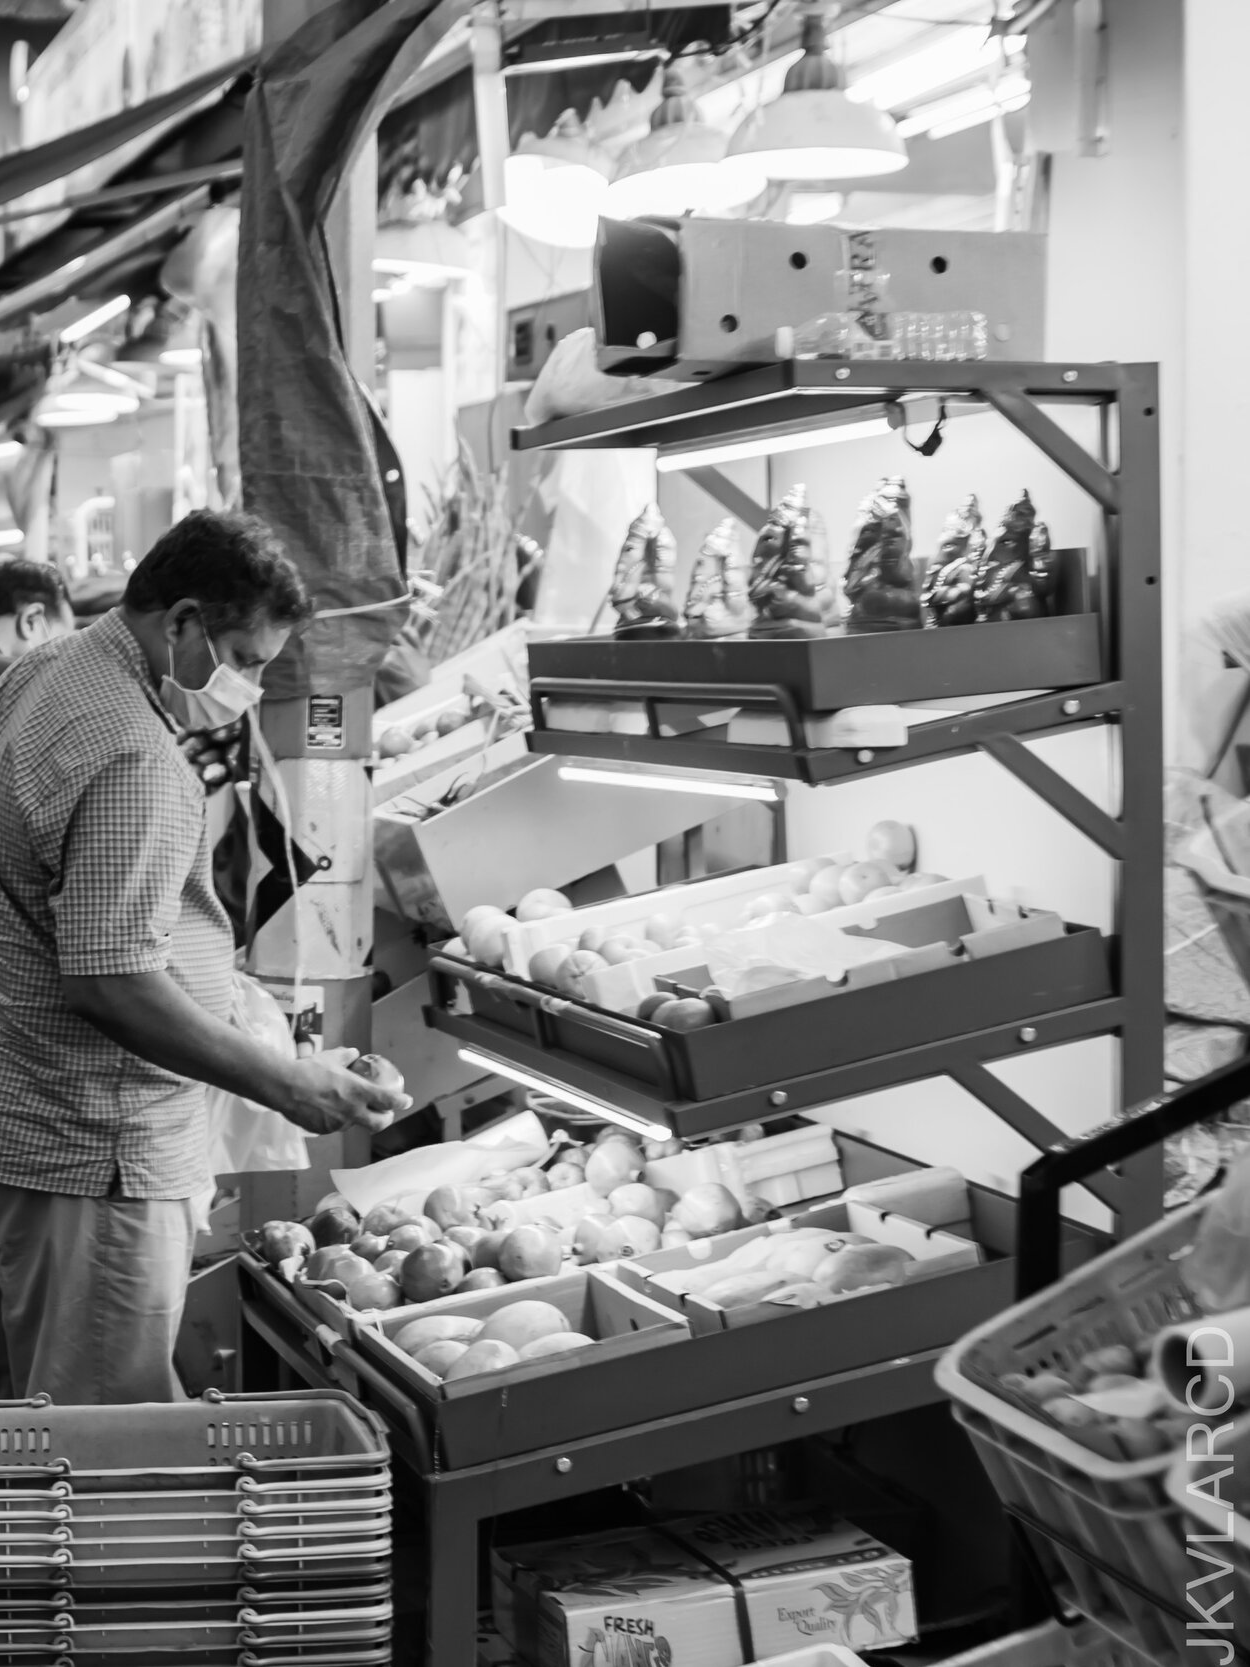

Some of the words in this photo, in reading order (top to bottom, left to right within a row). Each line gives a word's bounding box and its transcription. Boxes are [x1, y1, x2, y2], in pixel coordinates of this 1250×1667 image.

[777, 1607, 816, 1624] Export
[603, 1615, 654, 1637] FRESH
[795, 1617, 836, 1636] Quality
